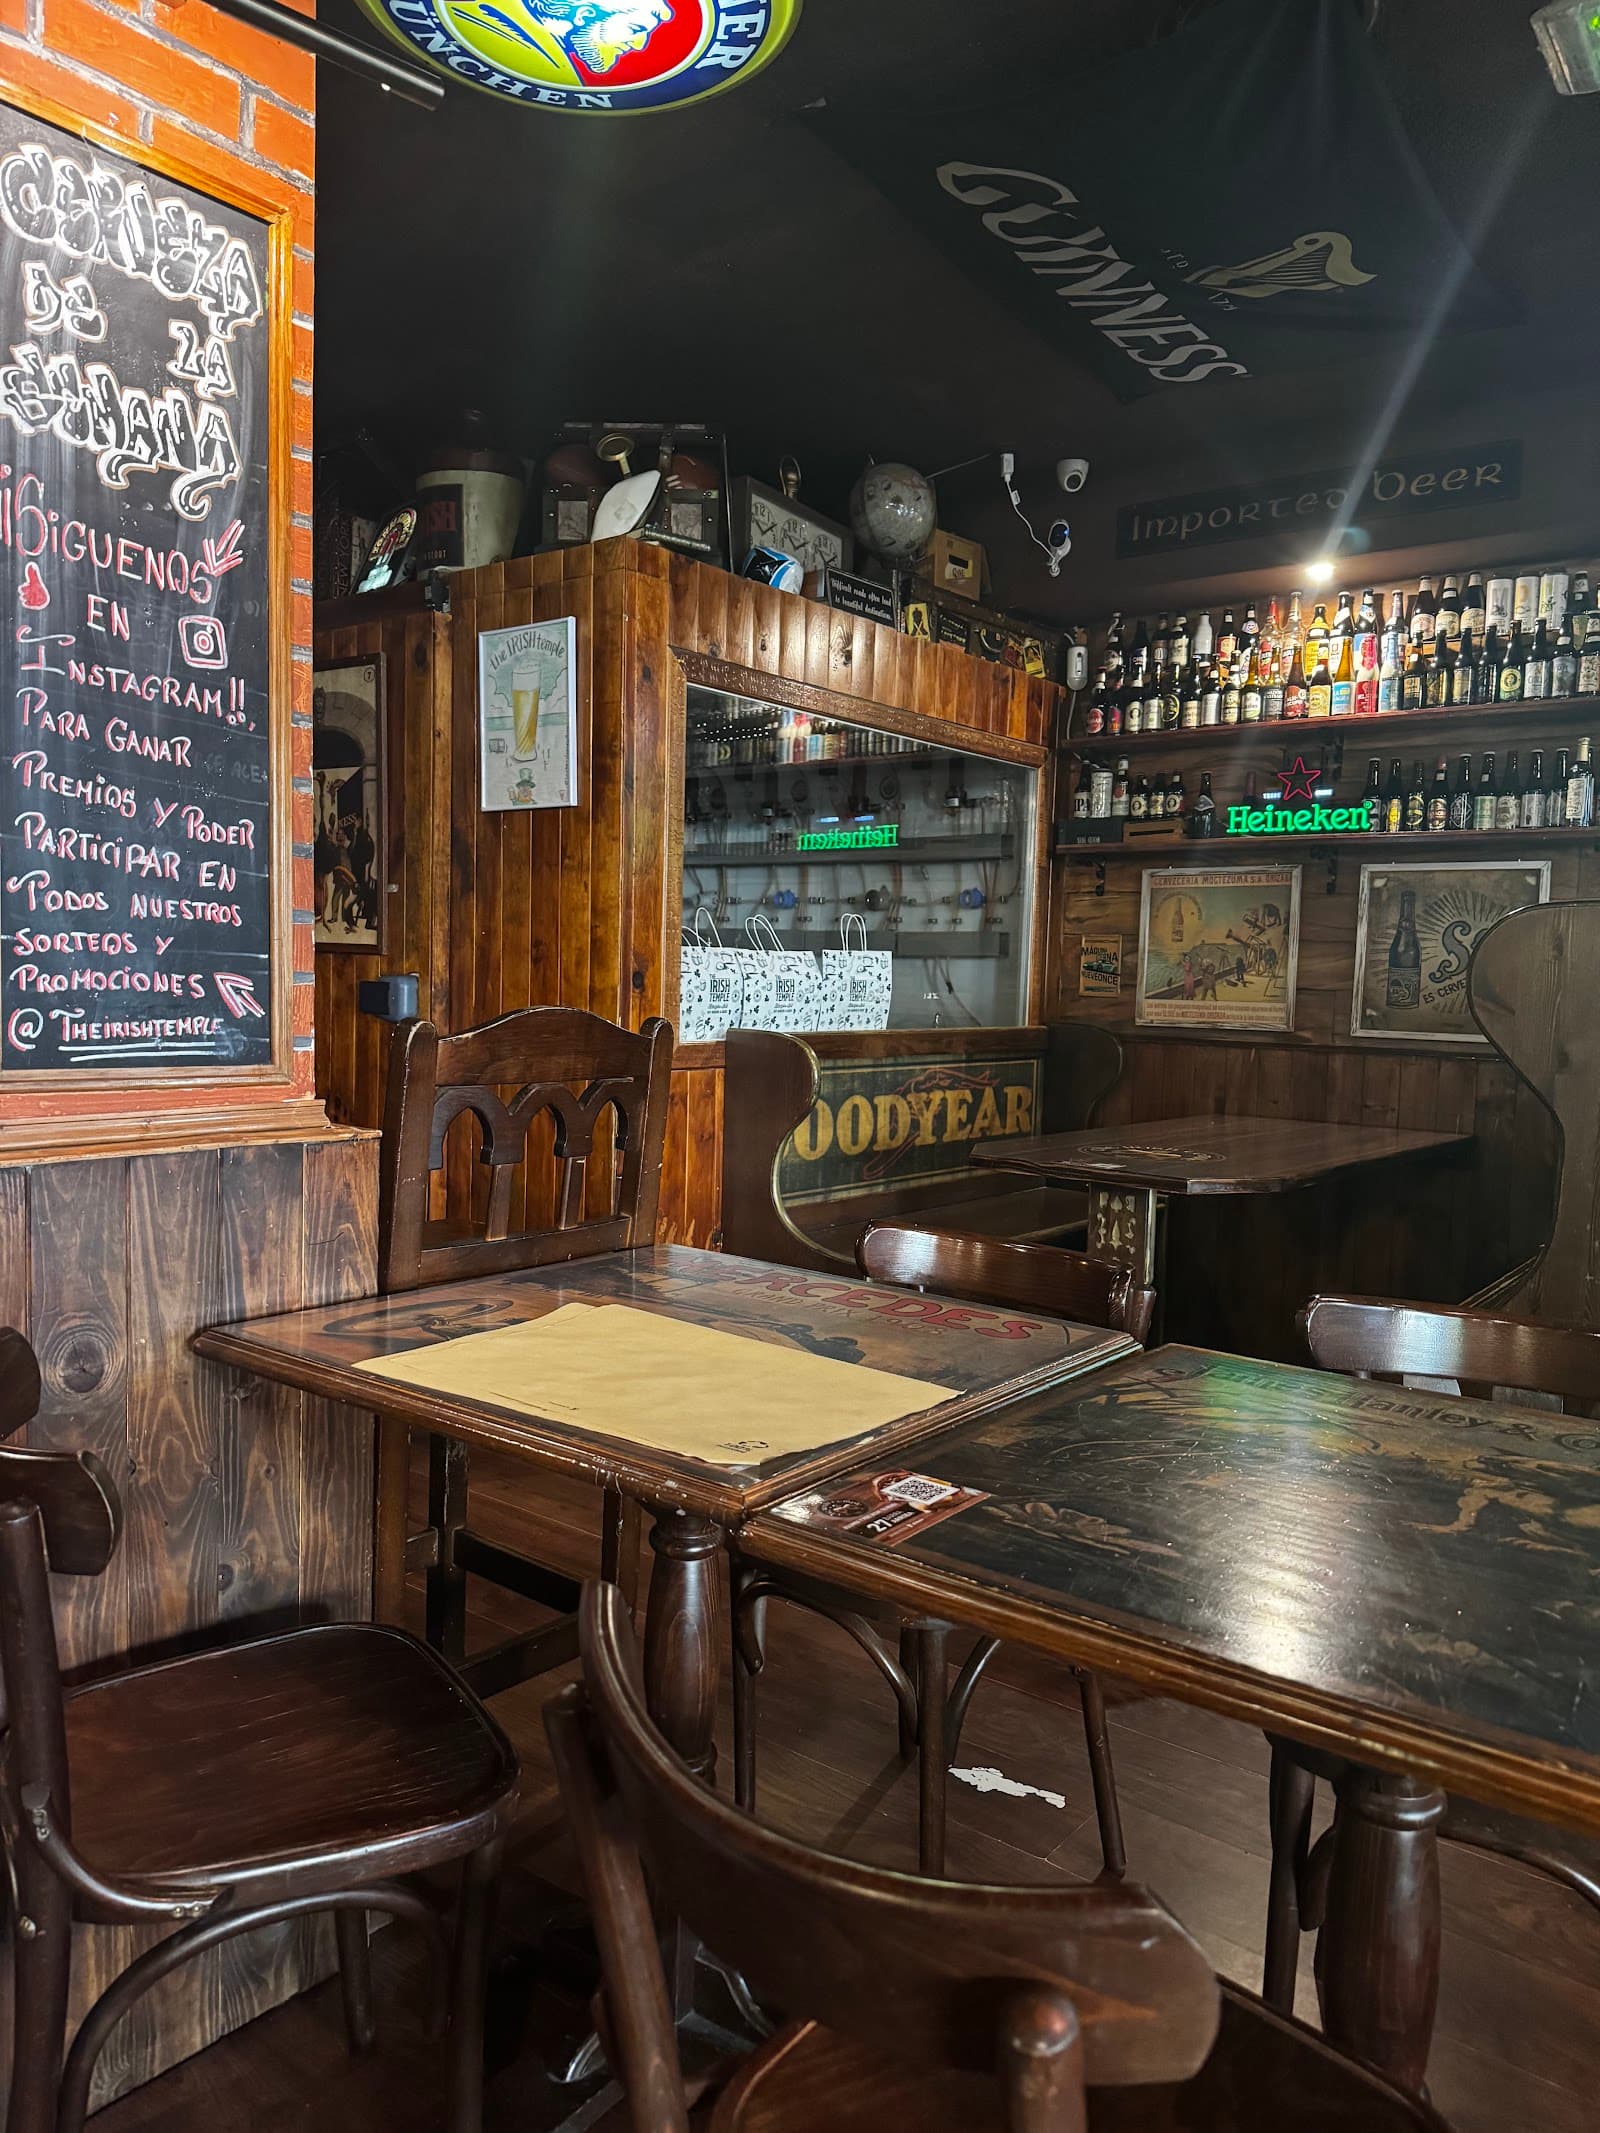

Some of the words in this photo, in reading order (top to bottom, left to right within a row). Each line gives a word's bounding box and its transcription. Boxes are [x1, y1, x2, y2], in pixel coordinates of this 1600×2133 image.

[935, 161, 1248, 382] GUINNESS
[87, 594, 130, 641] EN
[506, 631, 536, 657] IRISH
[537, 633, 566, 658] temple
[16, 687, 90, 741] PARA
[104, 717, 192, 768] GANAR
[12, 751, 137, 818] PREMIOS
[153, 797, 178, 829] Y
[181, 805, 255, 850] PODER
[1226, 804, 1372, 833] Heineken
[15, 811, 181, 882] PARTICIPAR
[199, 861, 236, 893] EN
[130, 893, 242, 927] NUESTROS
[13, 928, 138, 956] SORTEOS
[155, 935, 174, 955] Y
[10, 964, 206, 999] PROMOCIONES
[709, 979, 731, 992] IRISH
[775, 979, 795, 992] IRISH
[709, 993, 730, 1002] TEMPLE
[775, 993, 795, 1002] TEMPLE
[1423, 992, 1436, 1004] ES
[784, 1086, 1032, 1161] OODYEAR
[733, 1287, 803, 1305] GRAND
[807, 1301, 861, 1319] PRIX
[1499, 1423, 1538, 1441] &
[866, 1518, 893, 1533] 27
